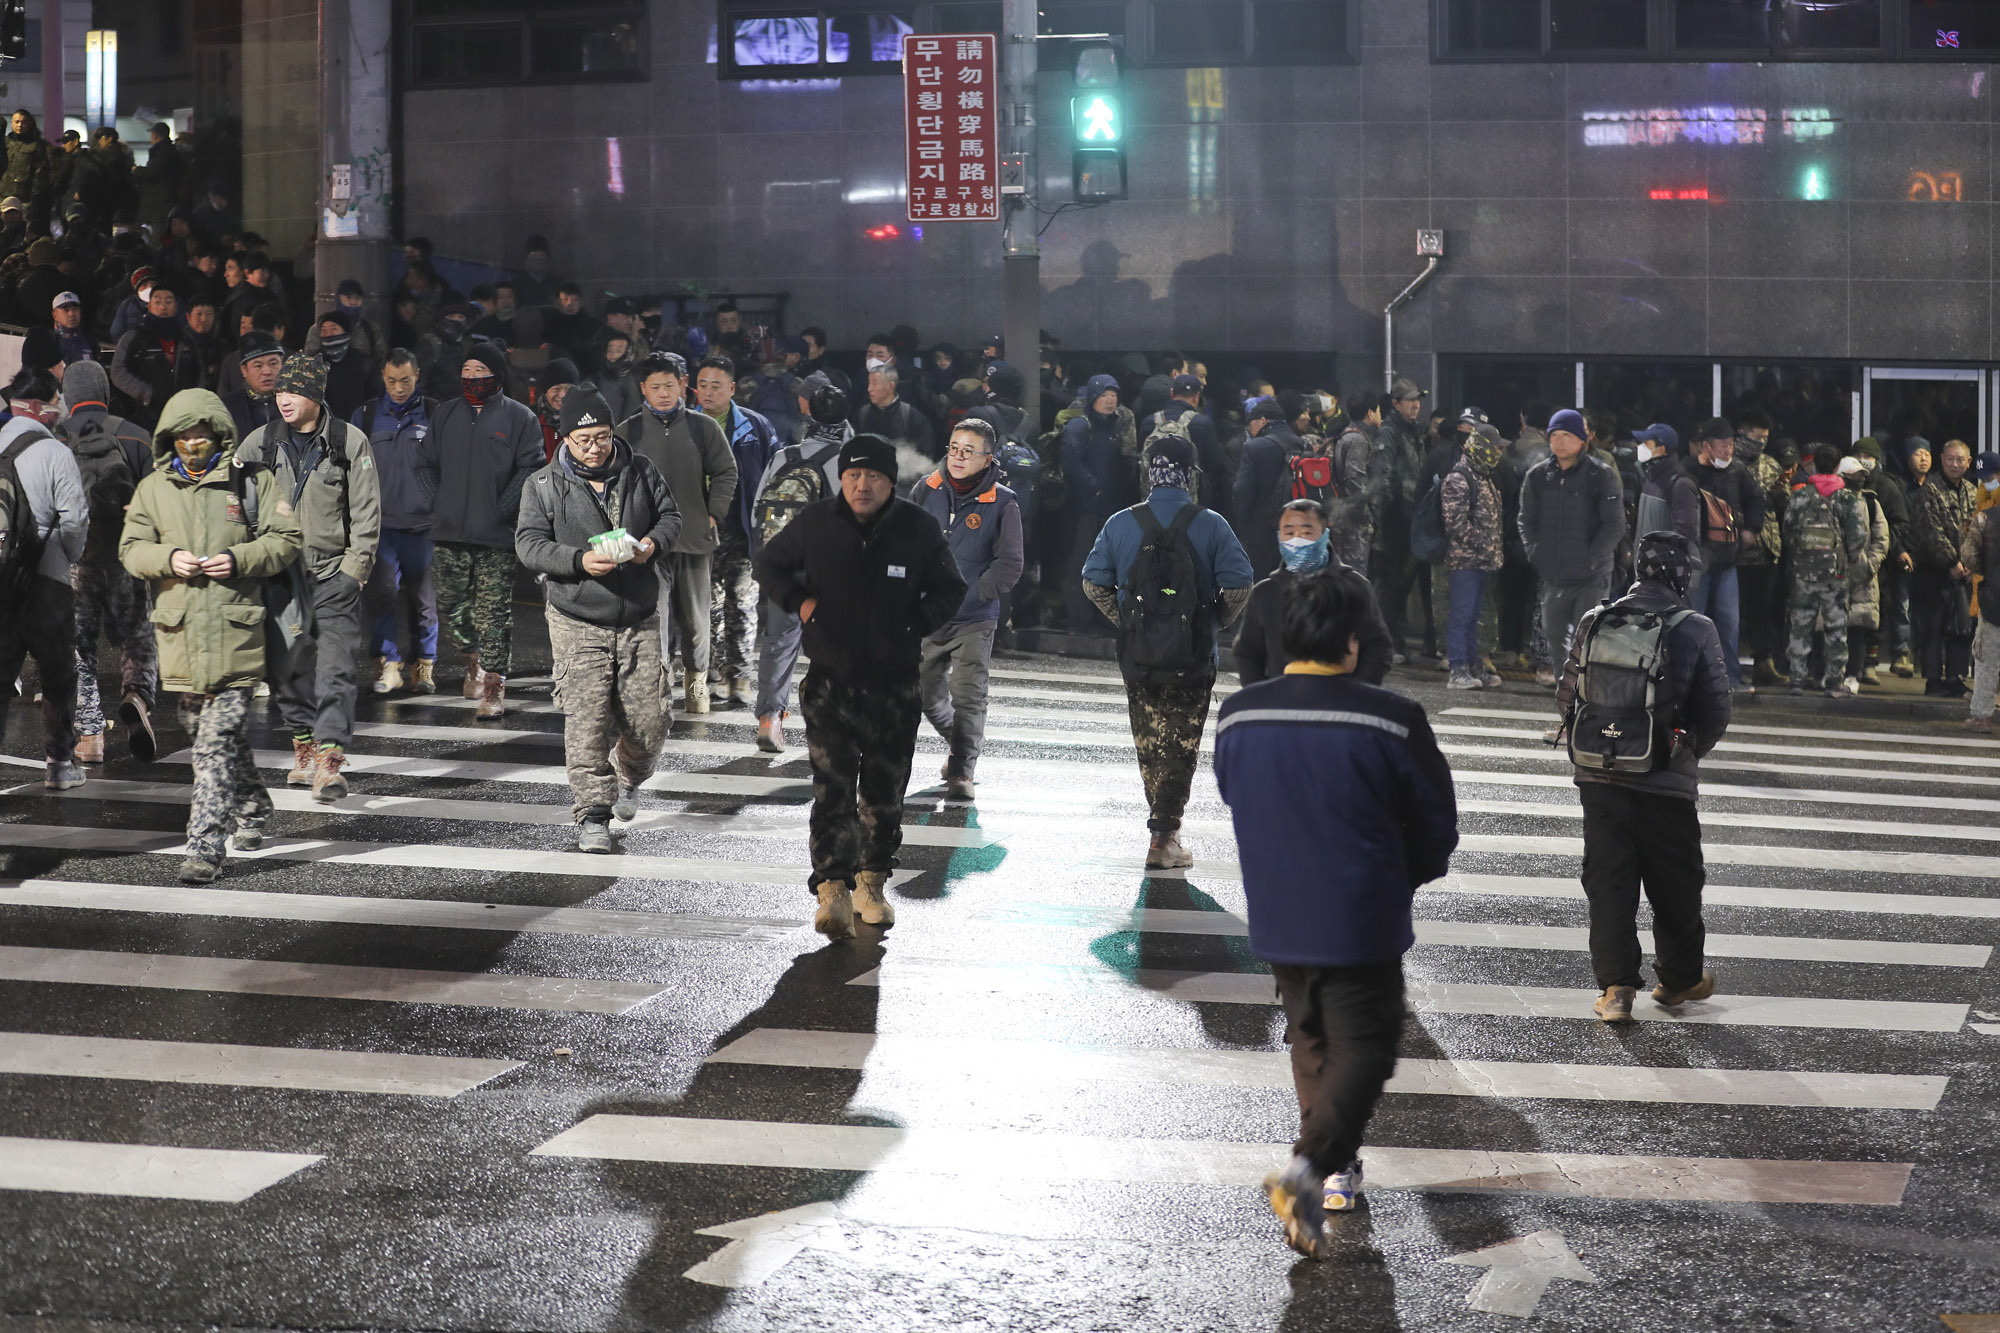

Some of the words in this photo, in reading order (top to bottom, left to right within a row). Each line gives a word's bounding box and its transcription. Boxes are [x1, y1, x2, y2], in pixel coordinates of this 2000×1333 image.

[914, 40, 944, 181] 무단횡단금지
[956, 40, 986, 181] 請勿橫穿馬路
[912, 185, 994, 200] 구로구청
[912, 203, 994, 217] 구로경찰서
